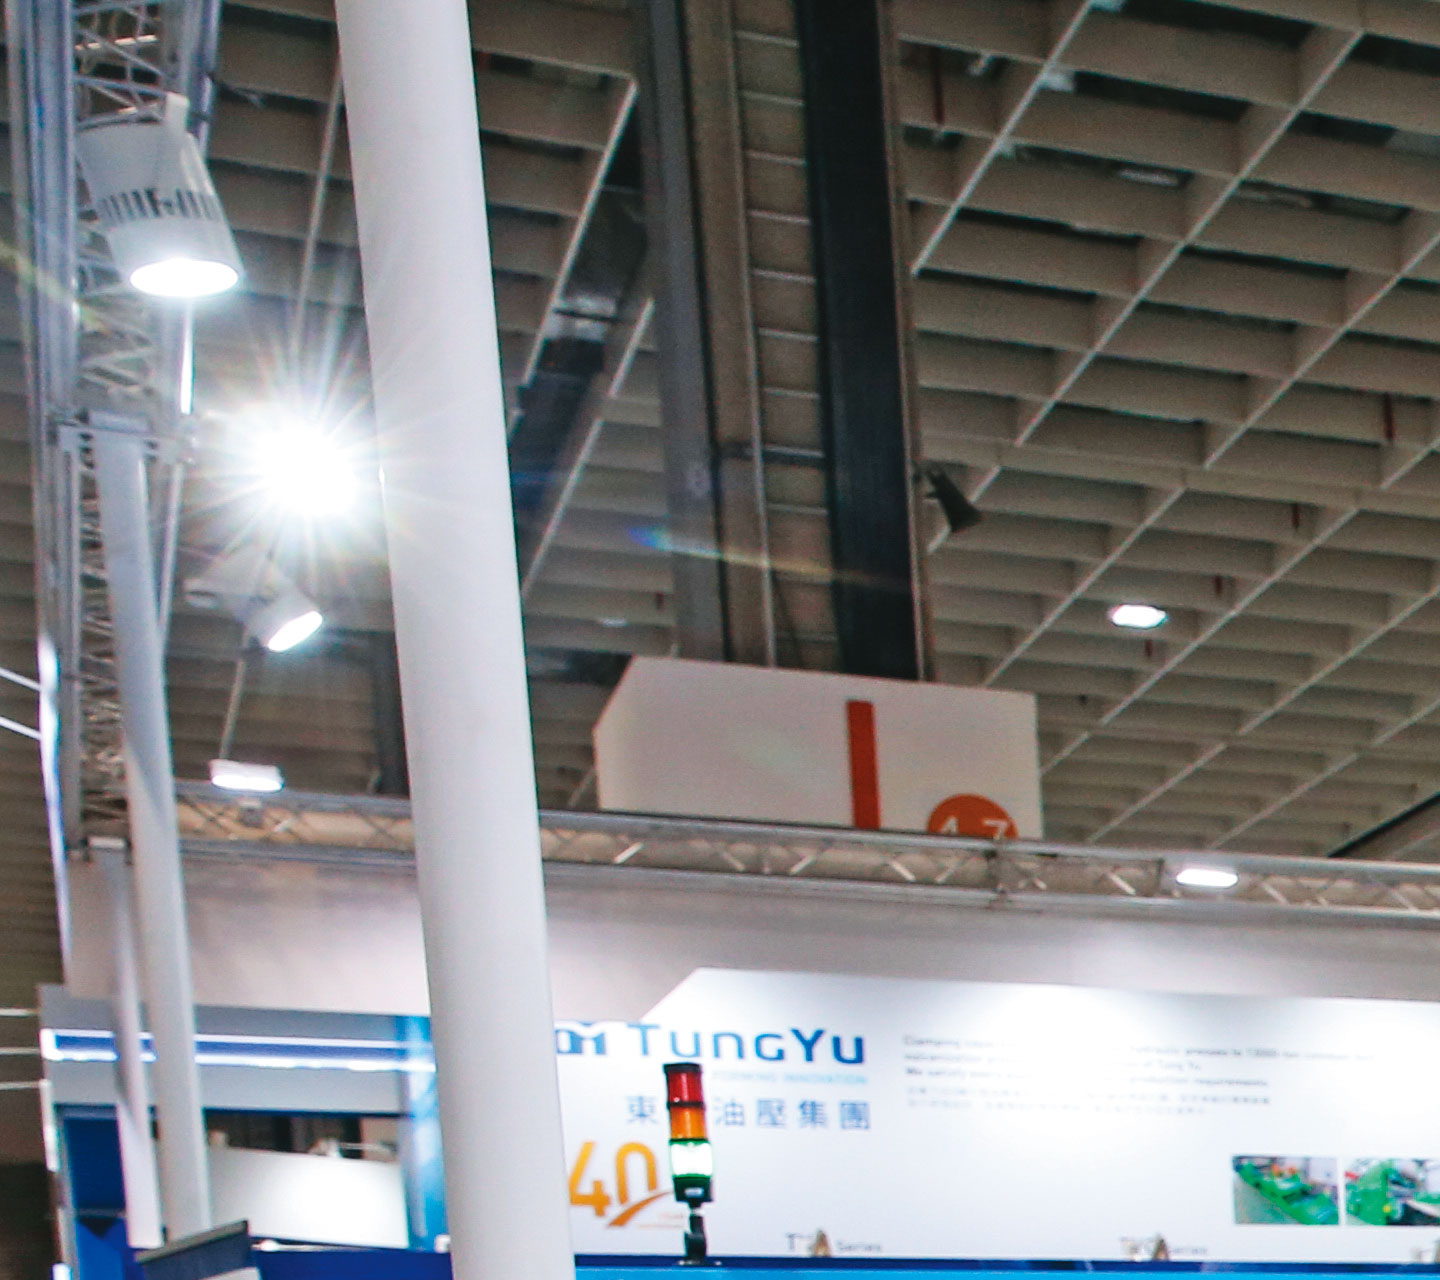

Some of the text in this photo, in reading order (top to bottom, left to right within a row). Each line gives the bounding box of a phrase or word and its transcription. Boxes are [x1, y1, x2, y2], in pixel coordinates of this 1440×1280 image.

[626, 1095, 870, 1131] 東油壓集團
